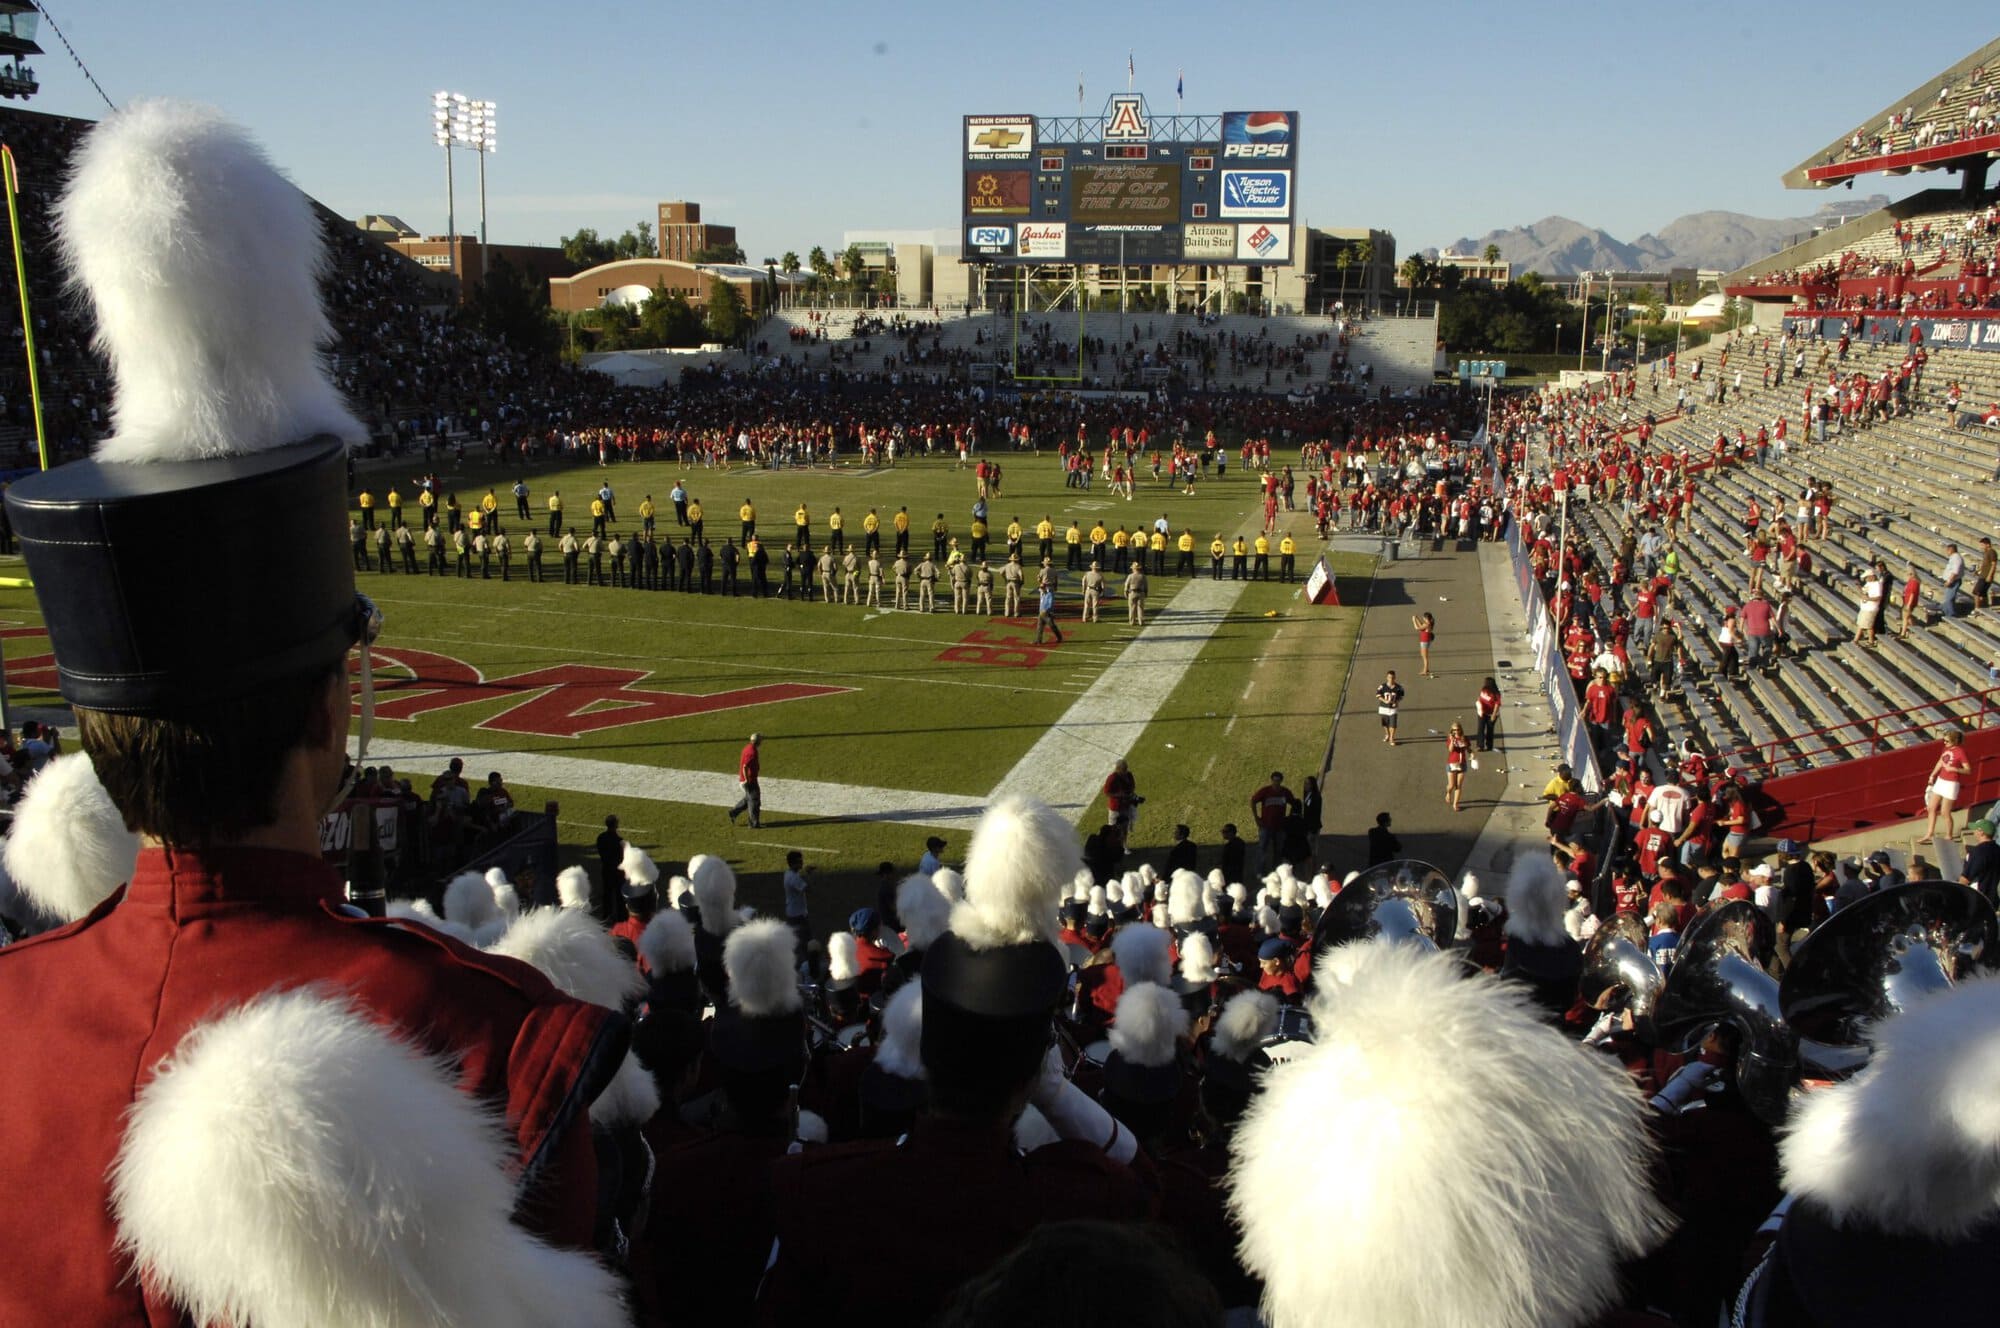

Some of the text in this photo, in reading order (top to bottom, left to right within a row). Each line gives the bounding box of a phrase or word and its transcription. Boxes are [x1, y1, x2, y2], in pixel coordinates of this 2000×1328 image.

[1104, 96, 1149, 139] A
[1224, 144, 1289, 157] PEPSI
[1093, 167, 1159, 179] PLEASE
[1240, 176, 1273, 187] Tucson
[1082, 182, 1169, 194] STAY OFF
[1242, 185, 1280, 195] Electric
[971, 196, 1003, 206] DEL SOL
[1080, 197, 1170, 209] THE FIELD
[1246, 194, 1280, 204] Power
[975, 229, 1006, 243] FSN
[1190, 226, 1228, 236] Arizona
[1184, 237, 1210, 248] Daily
[1212, 237, 1233, 247] Star
